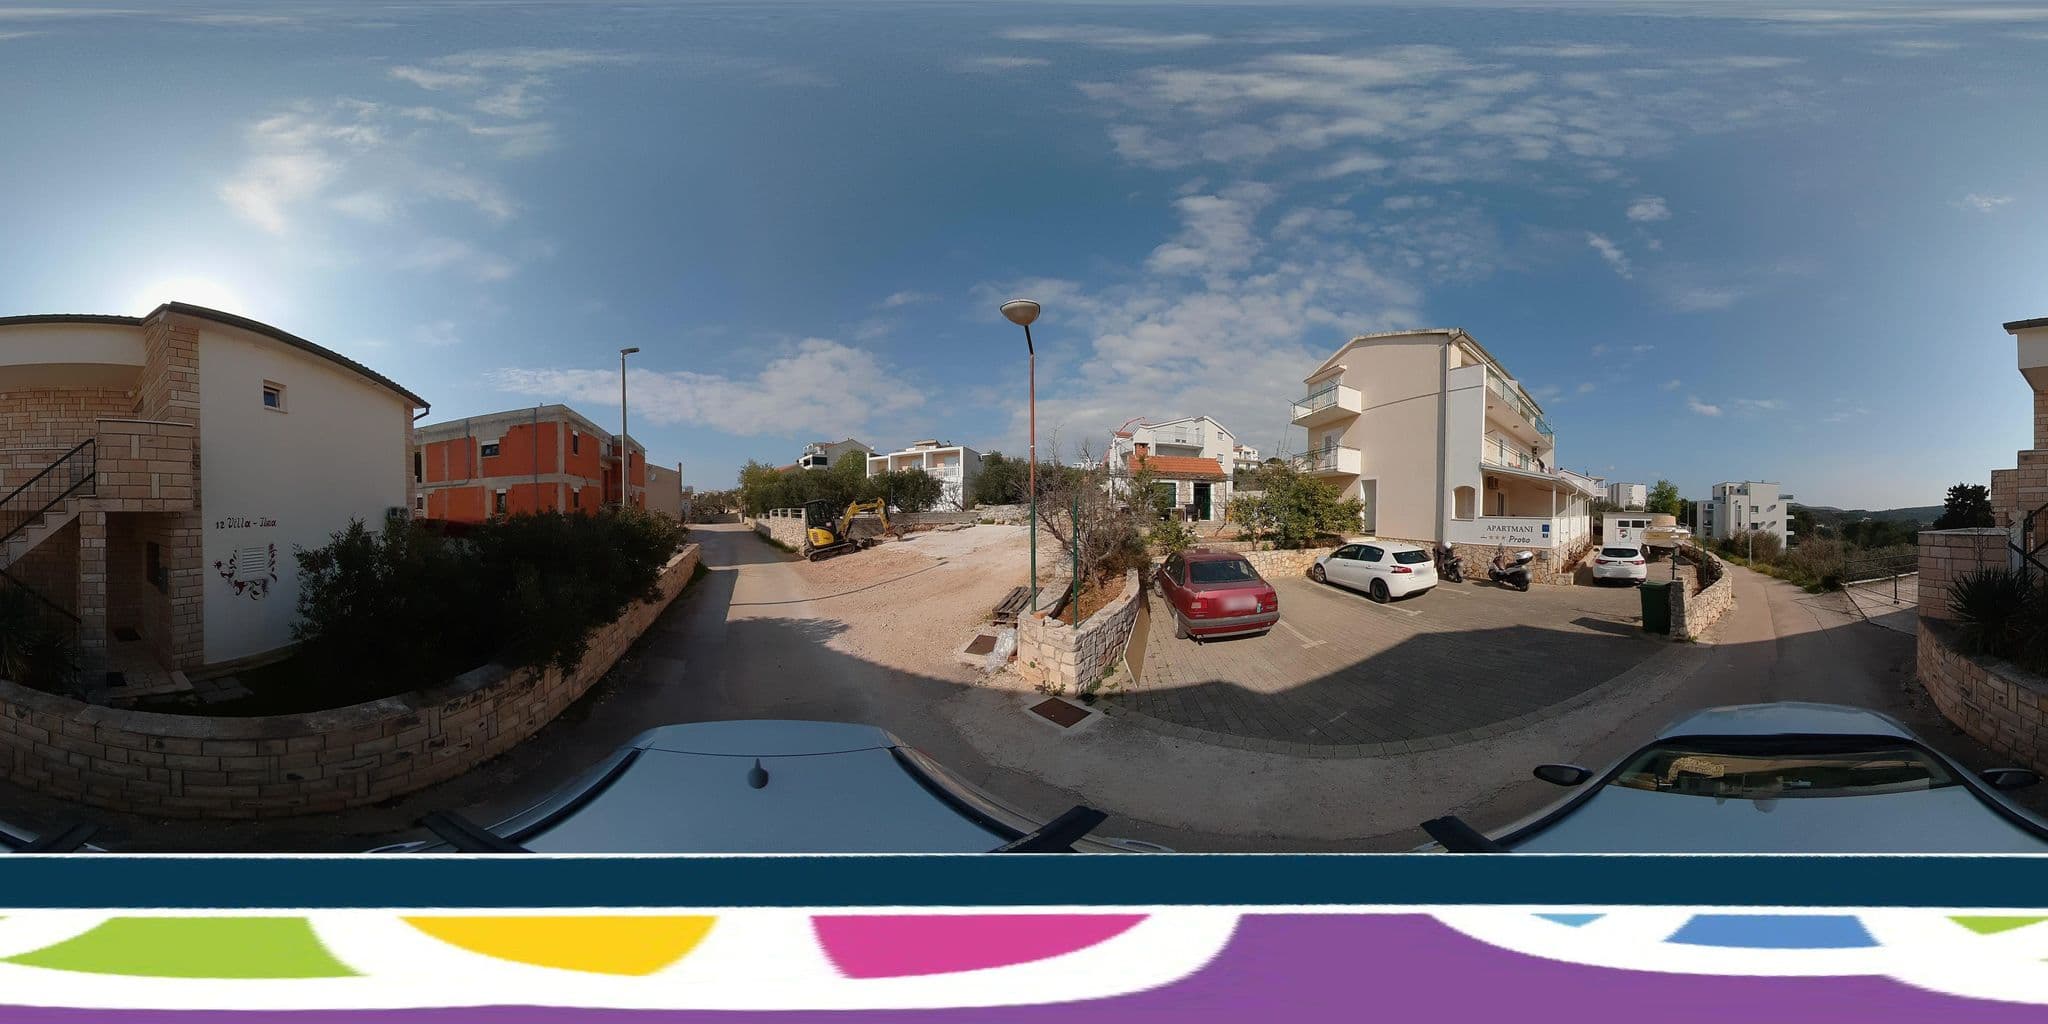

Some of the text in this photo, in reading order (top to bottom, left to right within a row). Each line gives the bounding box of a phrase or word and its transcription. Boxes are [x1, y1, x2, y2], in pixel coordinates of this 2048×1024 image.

[216, 520, 225, 529] 12
[226, 517, 251, 528] Villa
[1486, 525, 1534, 533] APARTMANI
